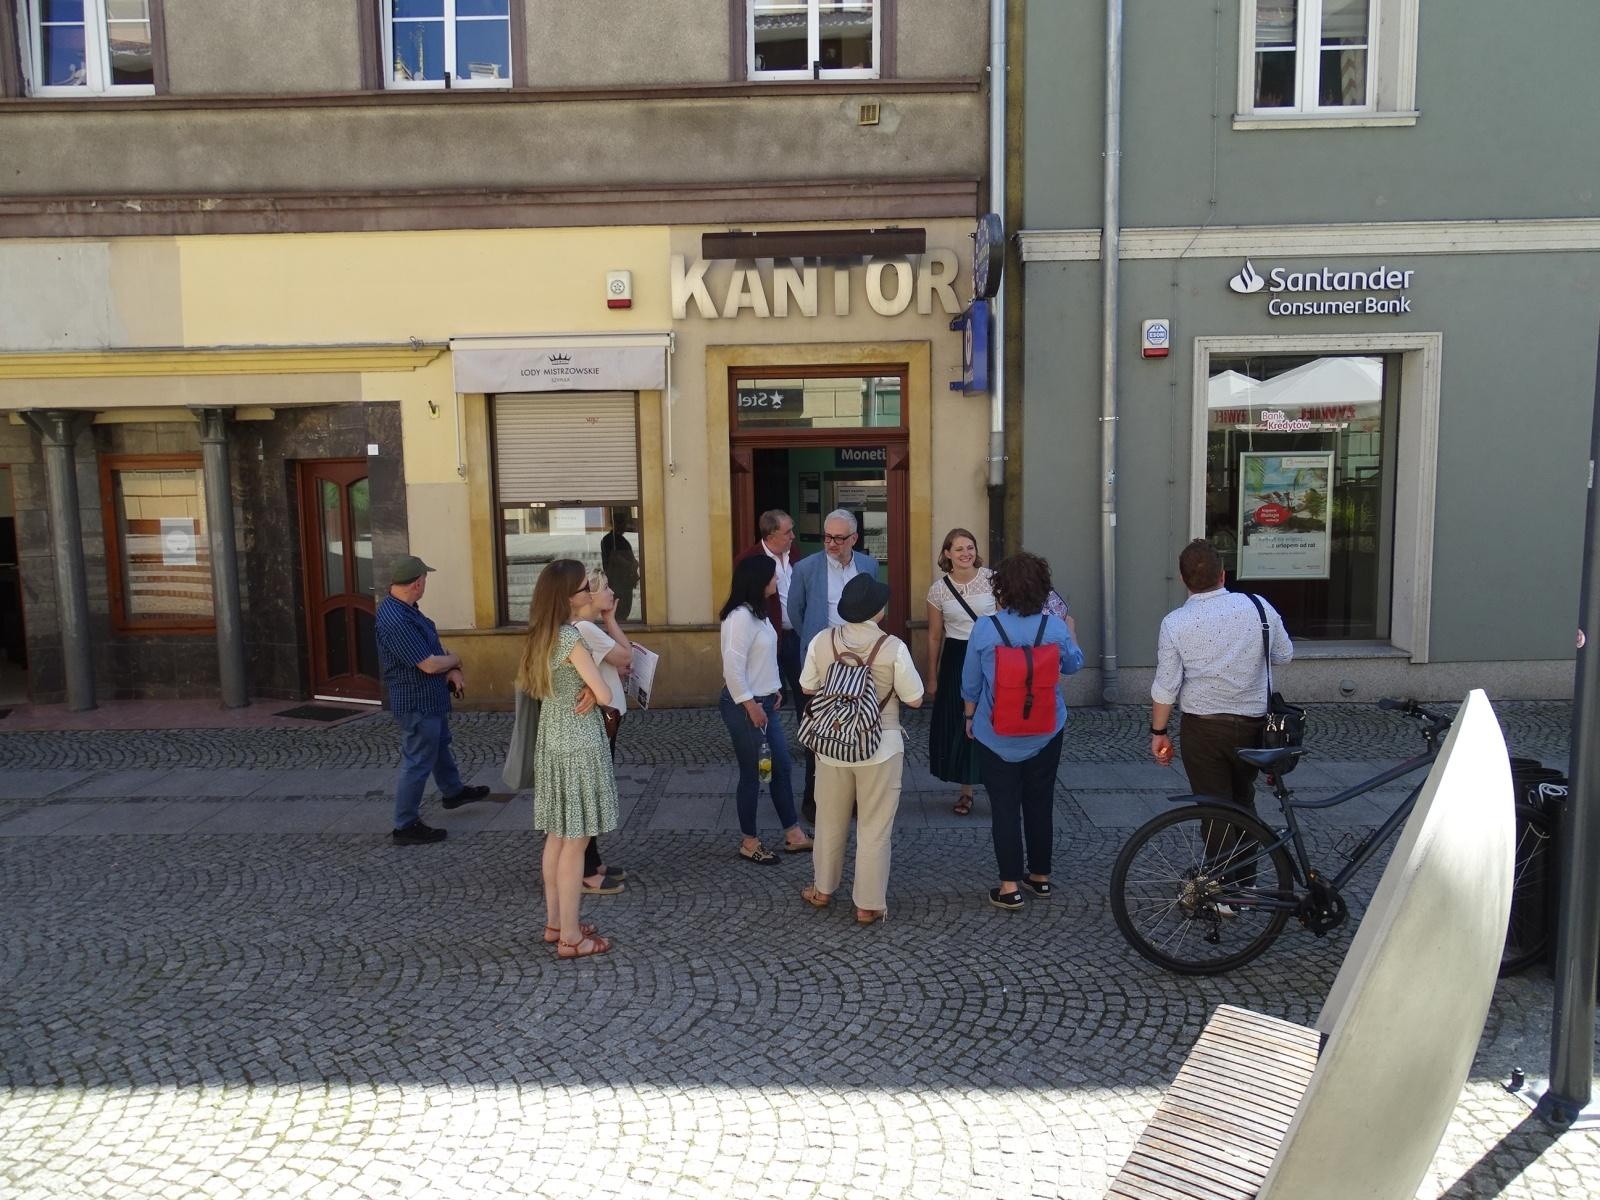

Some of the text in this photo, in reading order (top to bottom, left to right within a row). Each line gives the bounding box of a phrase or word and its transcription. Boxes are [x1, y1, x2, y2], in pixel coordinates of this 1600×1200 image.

[671, 248, 962, 319] KANTOR
[1269, 265, 1415, 292] Santander
[1268, 296, 1412, 316] Consumer Bank
[543, 367, 600, 375] MISTRZOWSKIE
[1262, 411, 1285, 421] Bank
[1268, 419, 1311, 432] Kredytów
